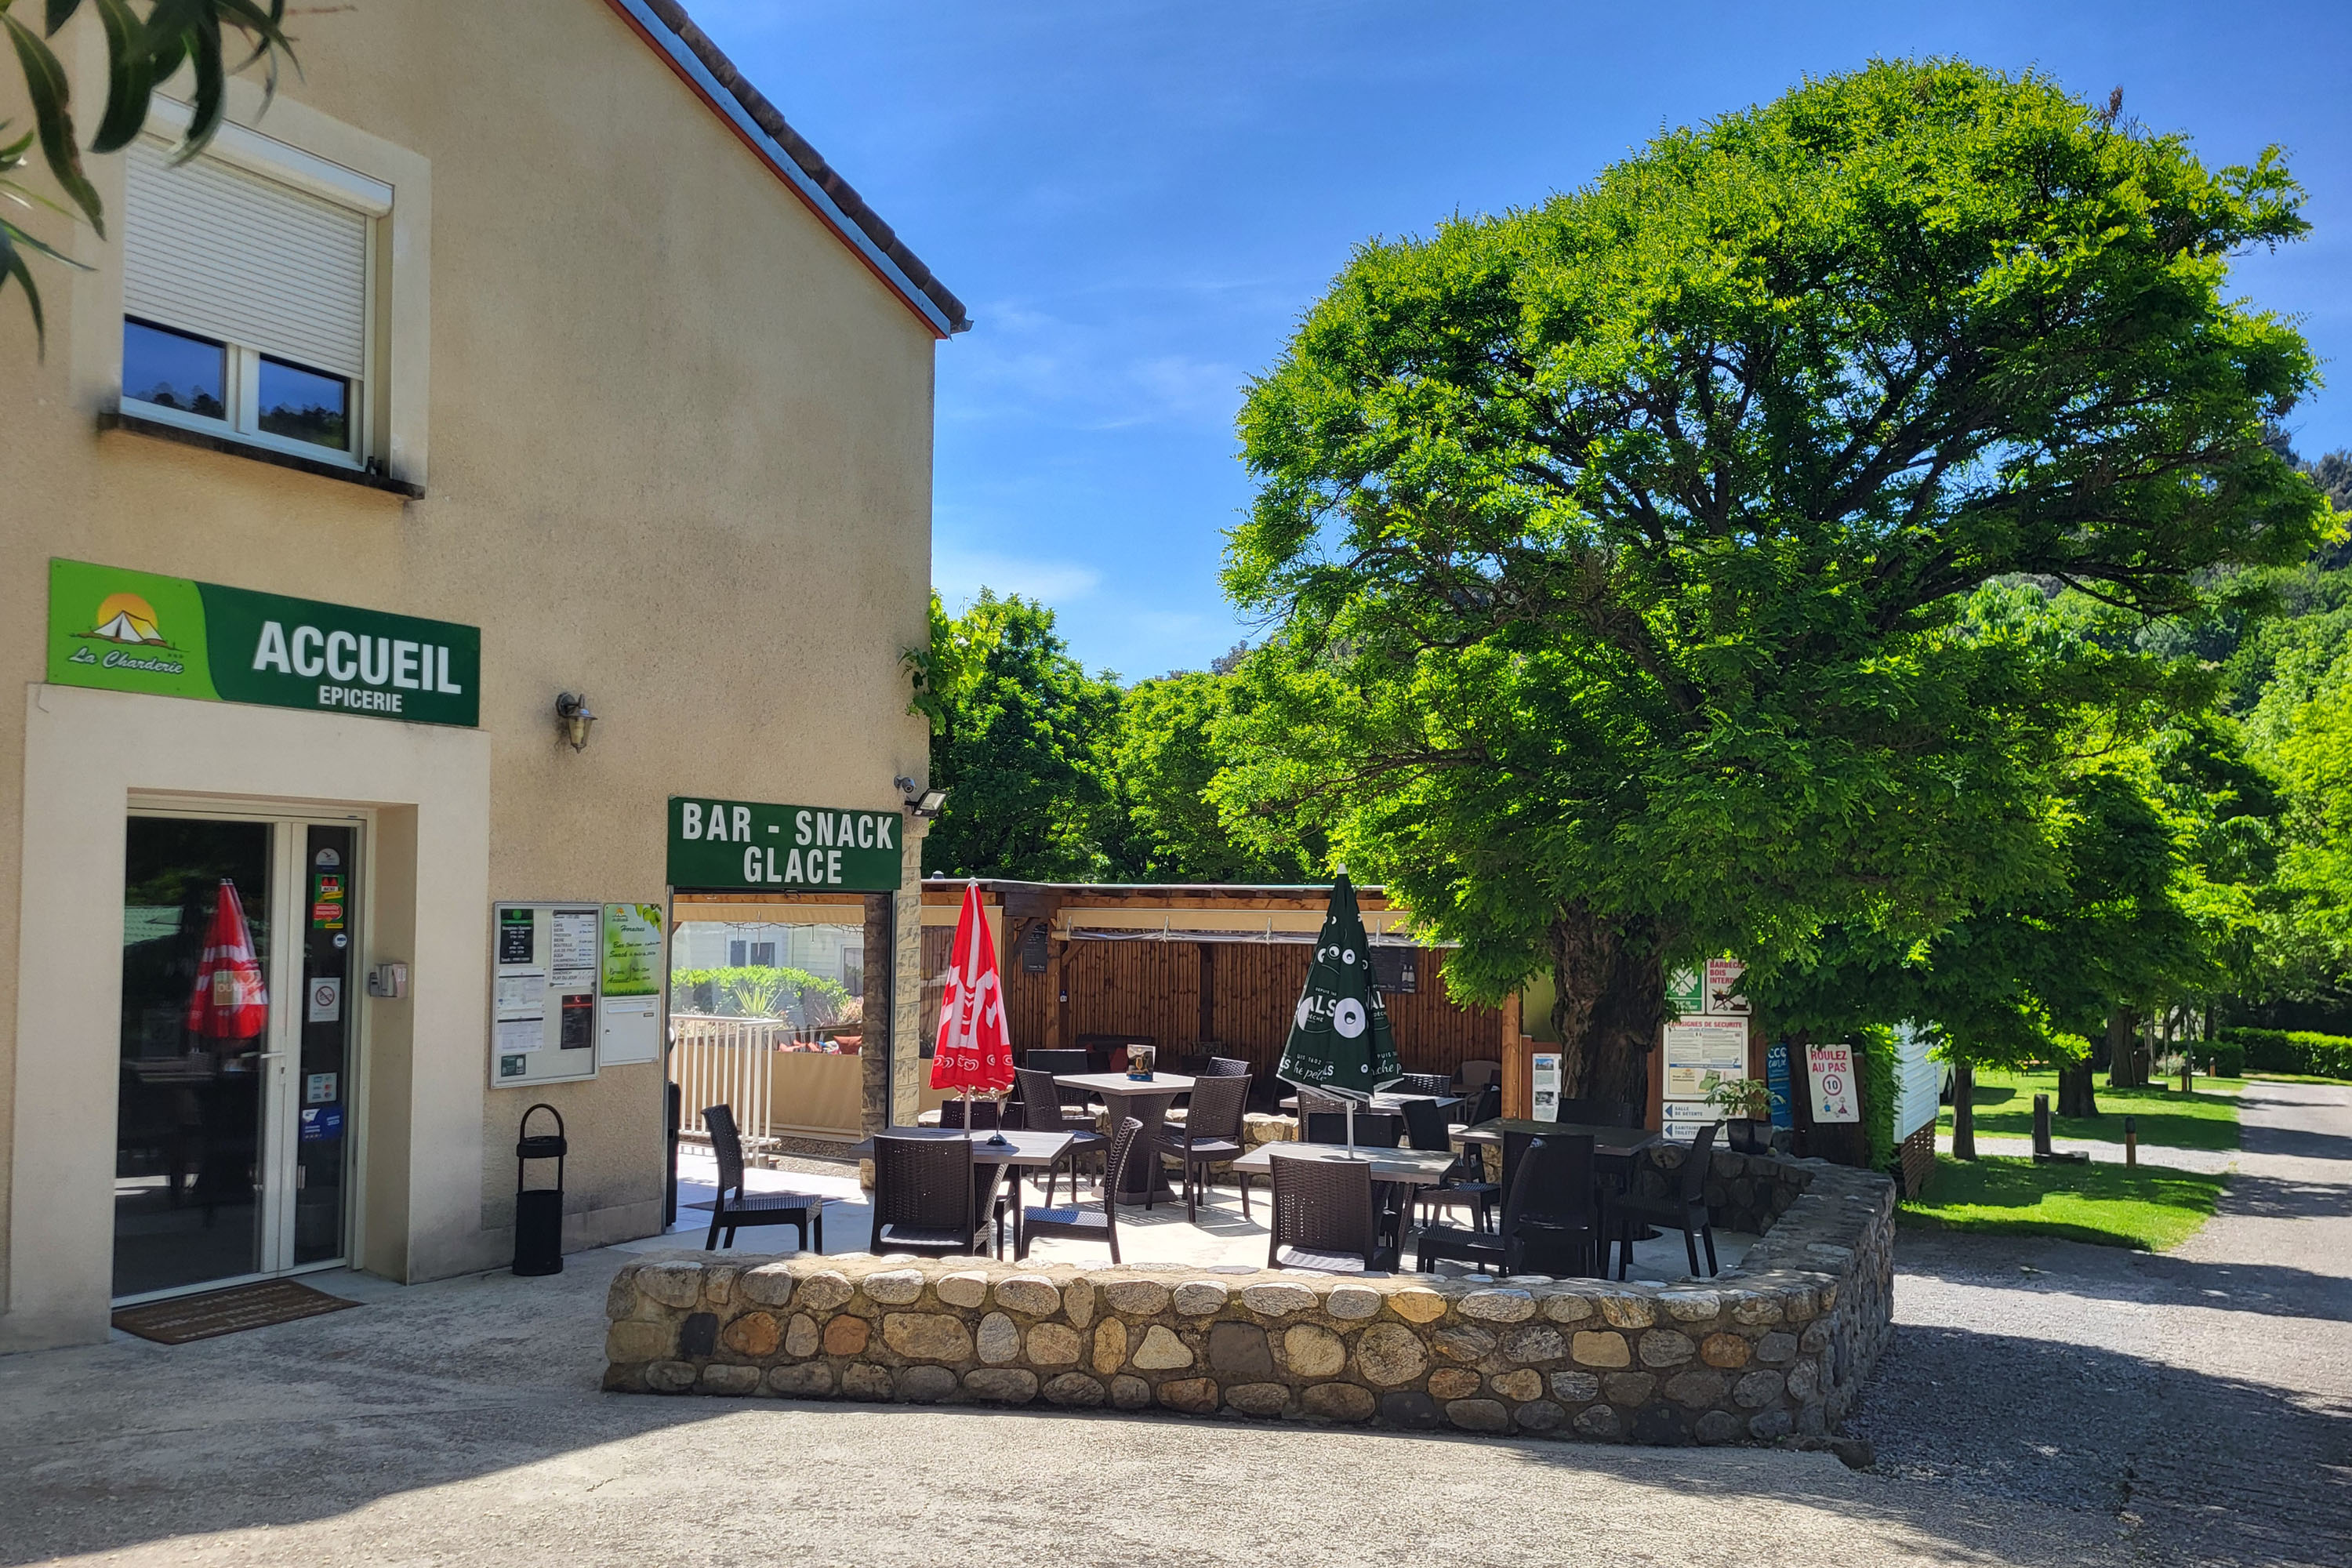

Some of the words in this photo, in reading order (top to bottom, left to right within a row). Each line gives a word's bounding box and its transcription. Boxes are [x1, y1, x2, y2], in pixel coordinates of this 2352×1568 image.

[69, 644, 96, 665] La
[102, 650, 184, 675] Charderie
[252, 620, 461, 695] ACCUEIL
[319, 684, 402, 713] EPICERIE
[682, 802, 751, 843] BAR
[795, 811, 894, 850] SNACK
[744, 846, 842, 884] GLACE
[1810, 1051, 1847, 1061] ROULEZ
[1812, 1063, 1825, 1073] AU
[1828, 1062, 1847, 1073] PAS
[1826, 1080, 1838, 1090] 10
